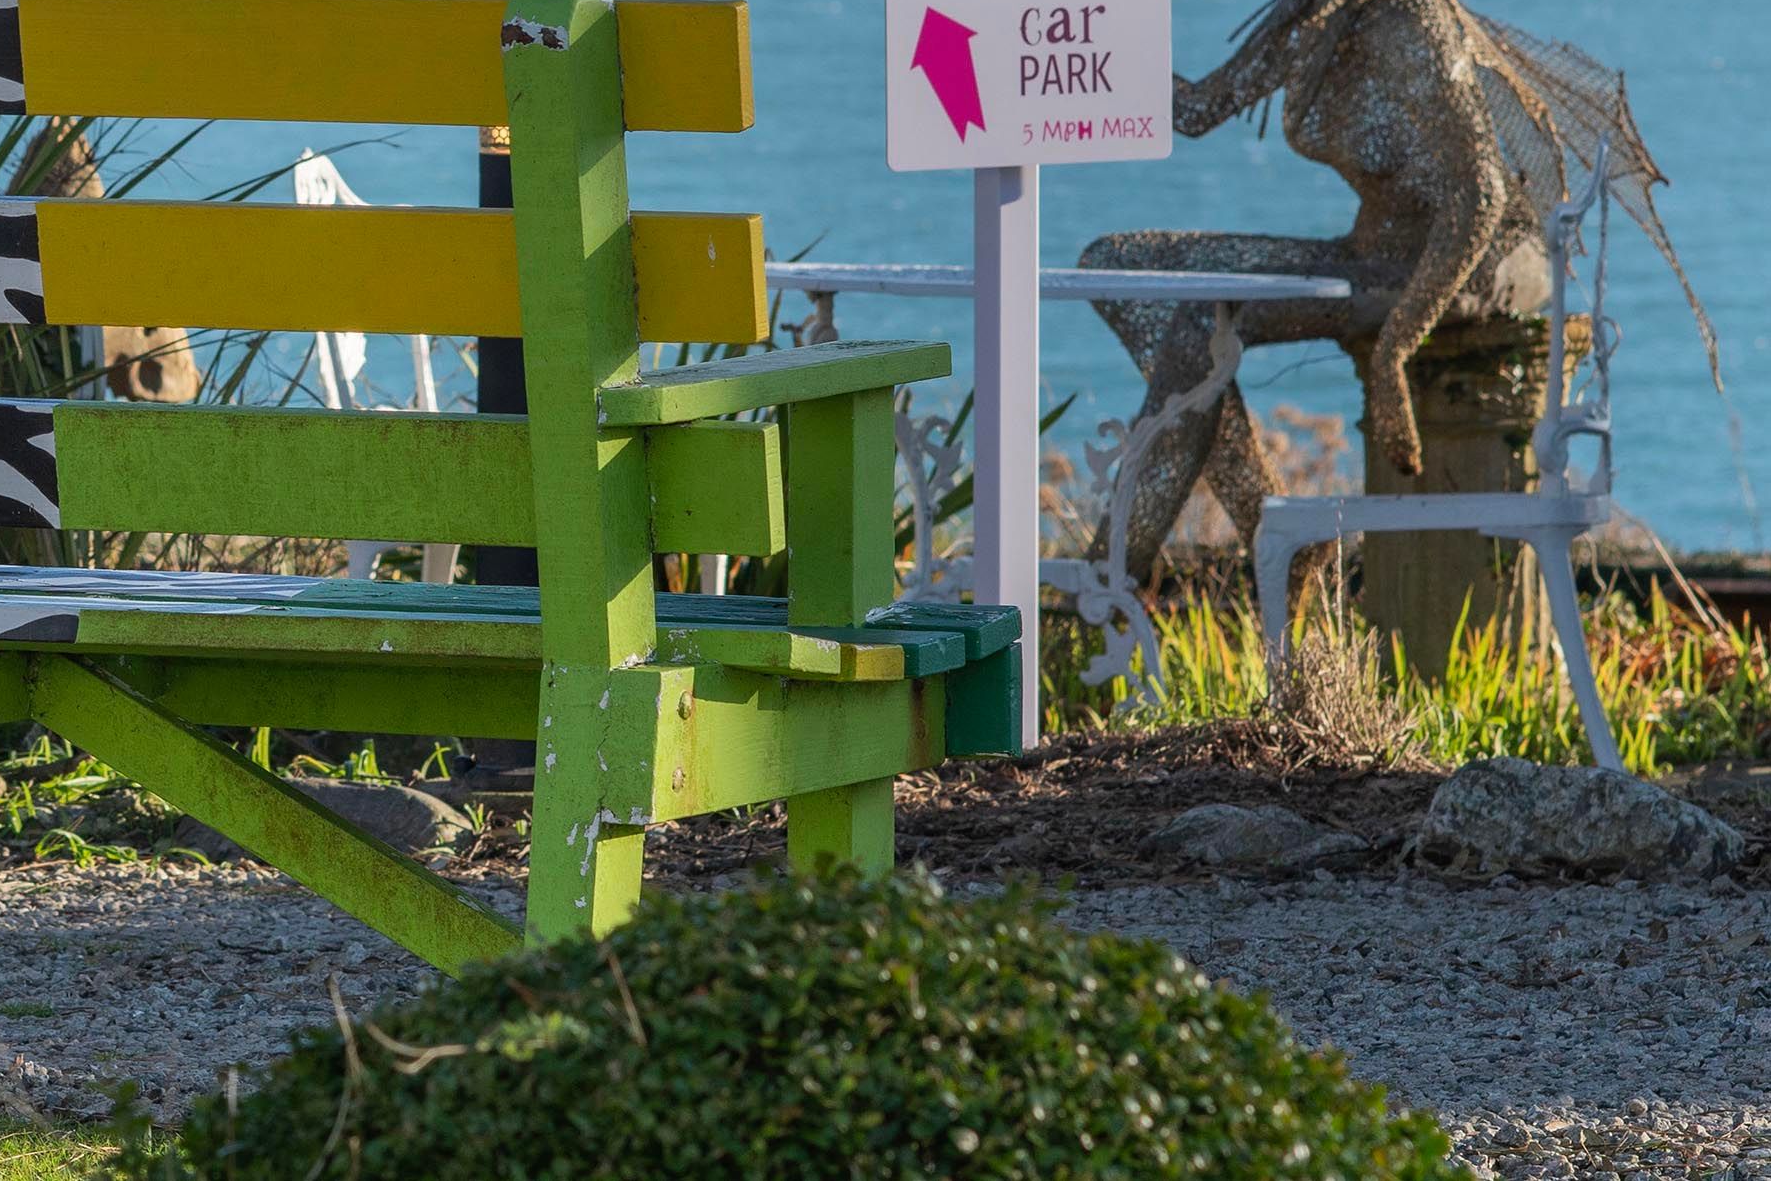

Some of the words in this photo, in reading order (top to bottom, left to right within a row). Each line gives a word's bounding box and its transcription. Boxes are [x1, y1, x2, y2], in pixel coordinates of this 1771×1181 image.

[1020, 50, 1113, 96] PARK
[1023, 123, 1034, 145] 5
[1101, 116, 1154, 139] MAX
